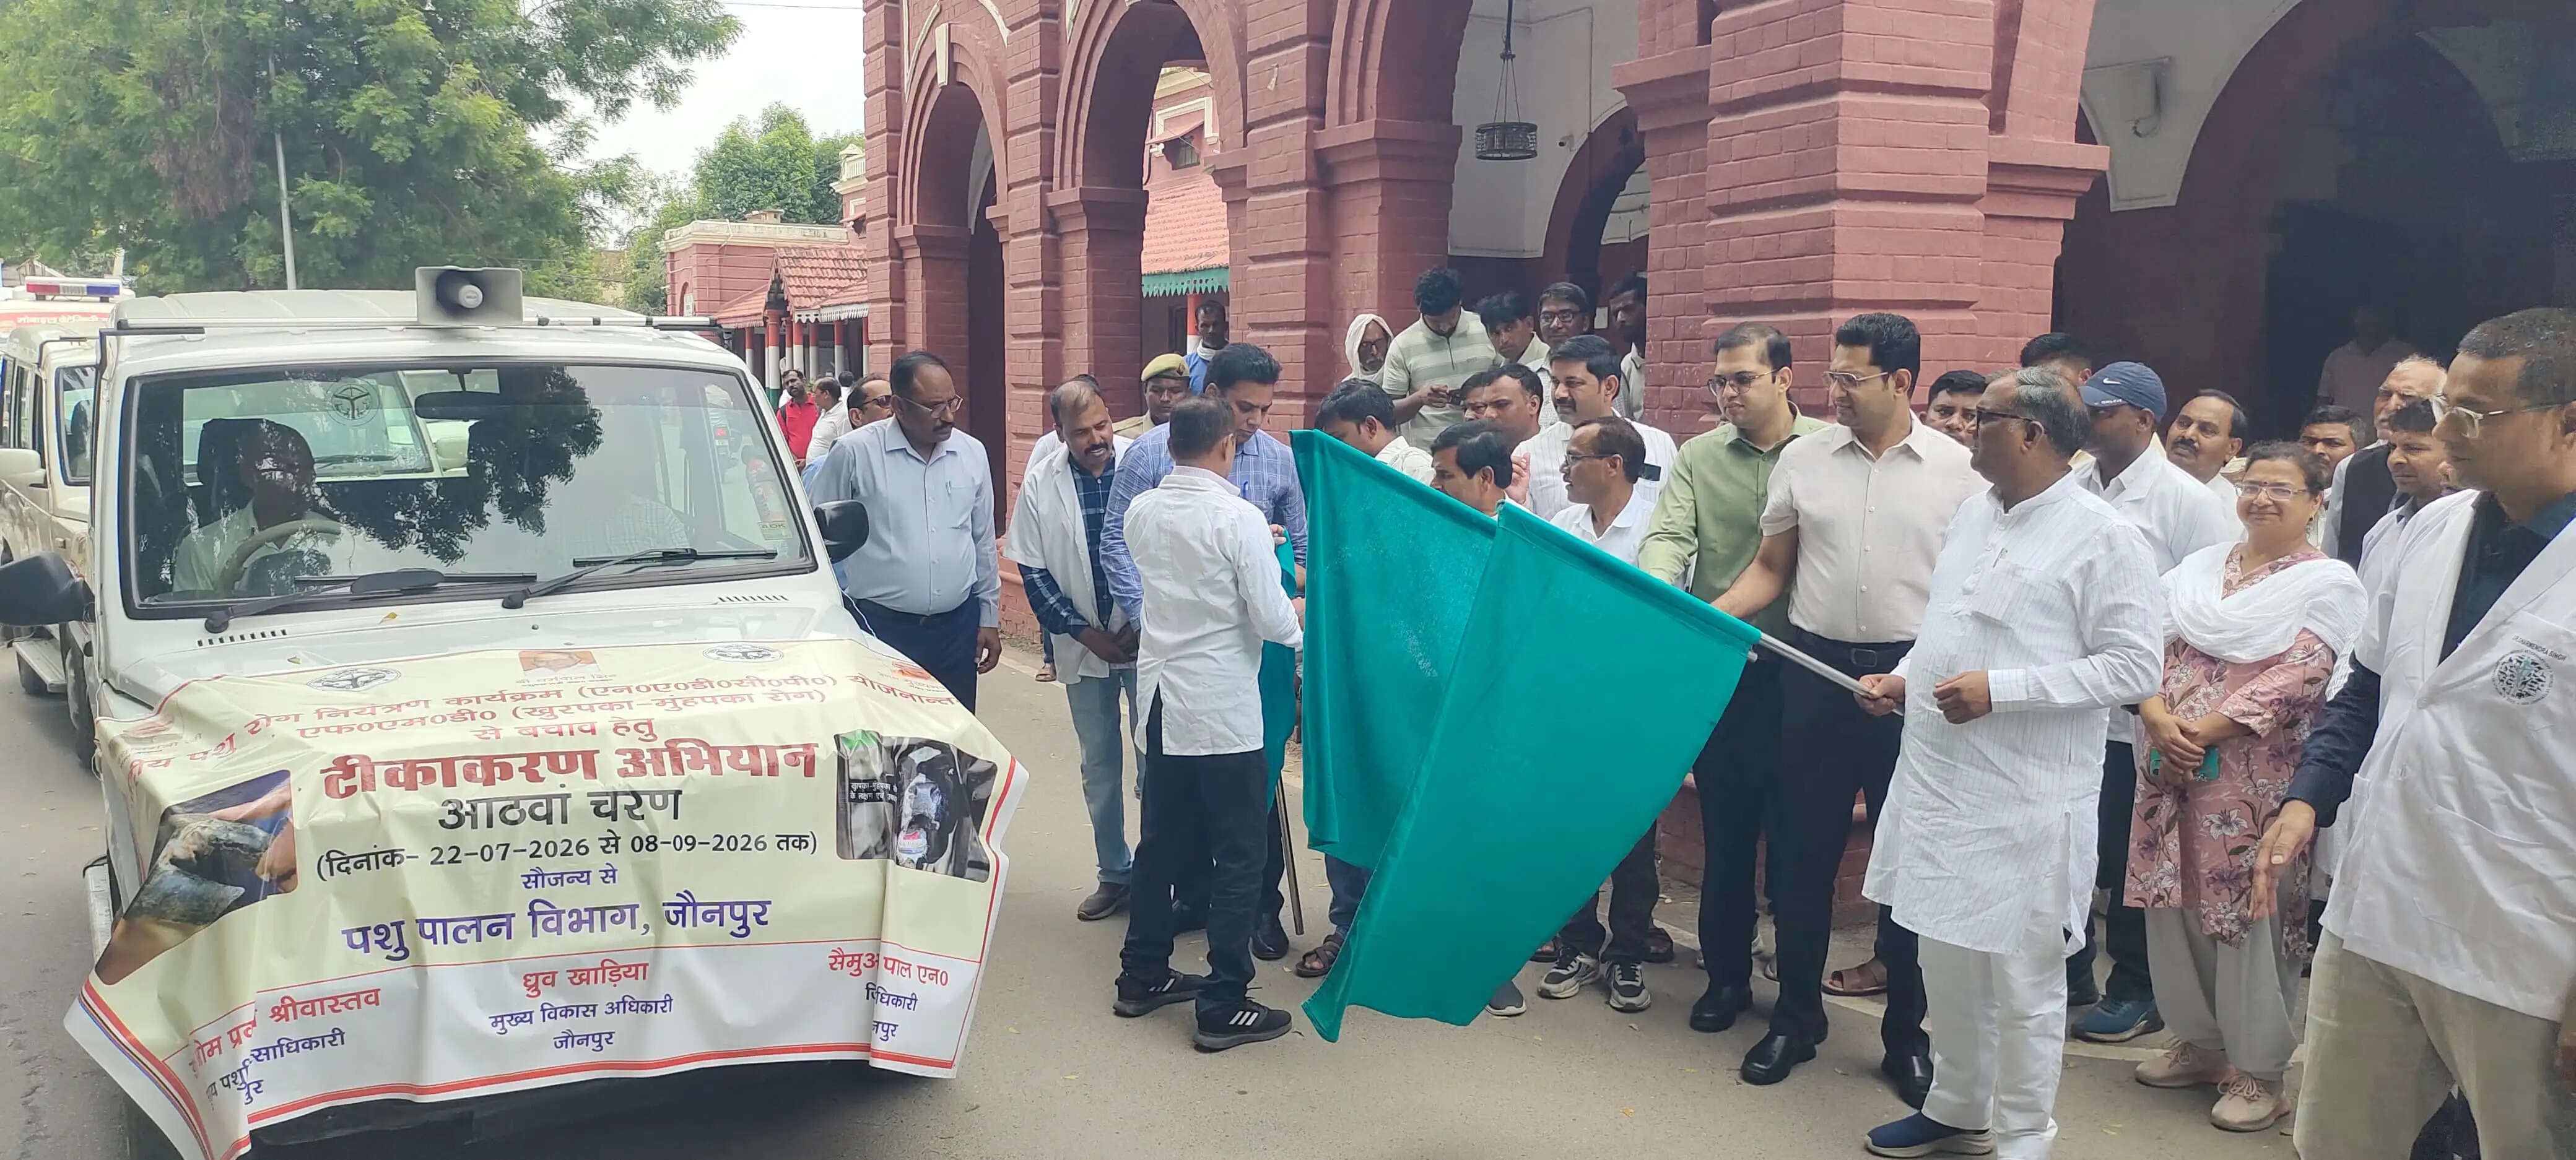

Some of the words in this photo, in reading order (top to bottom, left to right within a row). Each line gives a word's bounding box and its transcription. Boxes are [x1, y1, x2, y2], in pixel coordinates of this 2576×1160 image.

[244, 713, 305, 735] रोग
[442, 689, 564, 706] कार्यक्रम
[762, 689, 826, 703] रोग)
[470, 725, 503, 740] से
[514, 721, 598, 737] बचाव
[608, 716, 658, 742] हेतु
[320, 749, 600, 799] टीकाकरण
[615, 737, 819, 778] अभियान
[438, 783, 572, 830] आठवां
[586, 789, 683, 822] चरण
[317, 844, 419, 881] (दिनांक-
[430, 839, 590, 865] 22-07-2026
[598, 829, 621, 855] से
[630, 834, 768, 853] 08-09-2026
[775, 830, 817, 855] तक)
[521, 866, 592, 889] सौजन्य
[599, 862, 618, 885] से
[341, 920, 410, 961] पशु
[416, 912, 516, 945] पालन
[528, 898, 650, 938] विभाग,
[662, 889, 772, 938] जौनपुर
[522, 971, 559, 998] ध्रुव
[566, 958, 649, 987] खाड़िया
[883, 956, 912, 979] पाल
[269, 989, 381, 1023] श्रीवास्तव
[489, 1011, 534, 1035] मुख्य
[541, 1002, 598, 1023] विकास
[604, 993, 674, 1015] अधिकारी
[554, 1029, 616, 1052] जौनपुर
